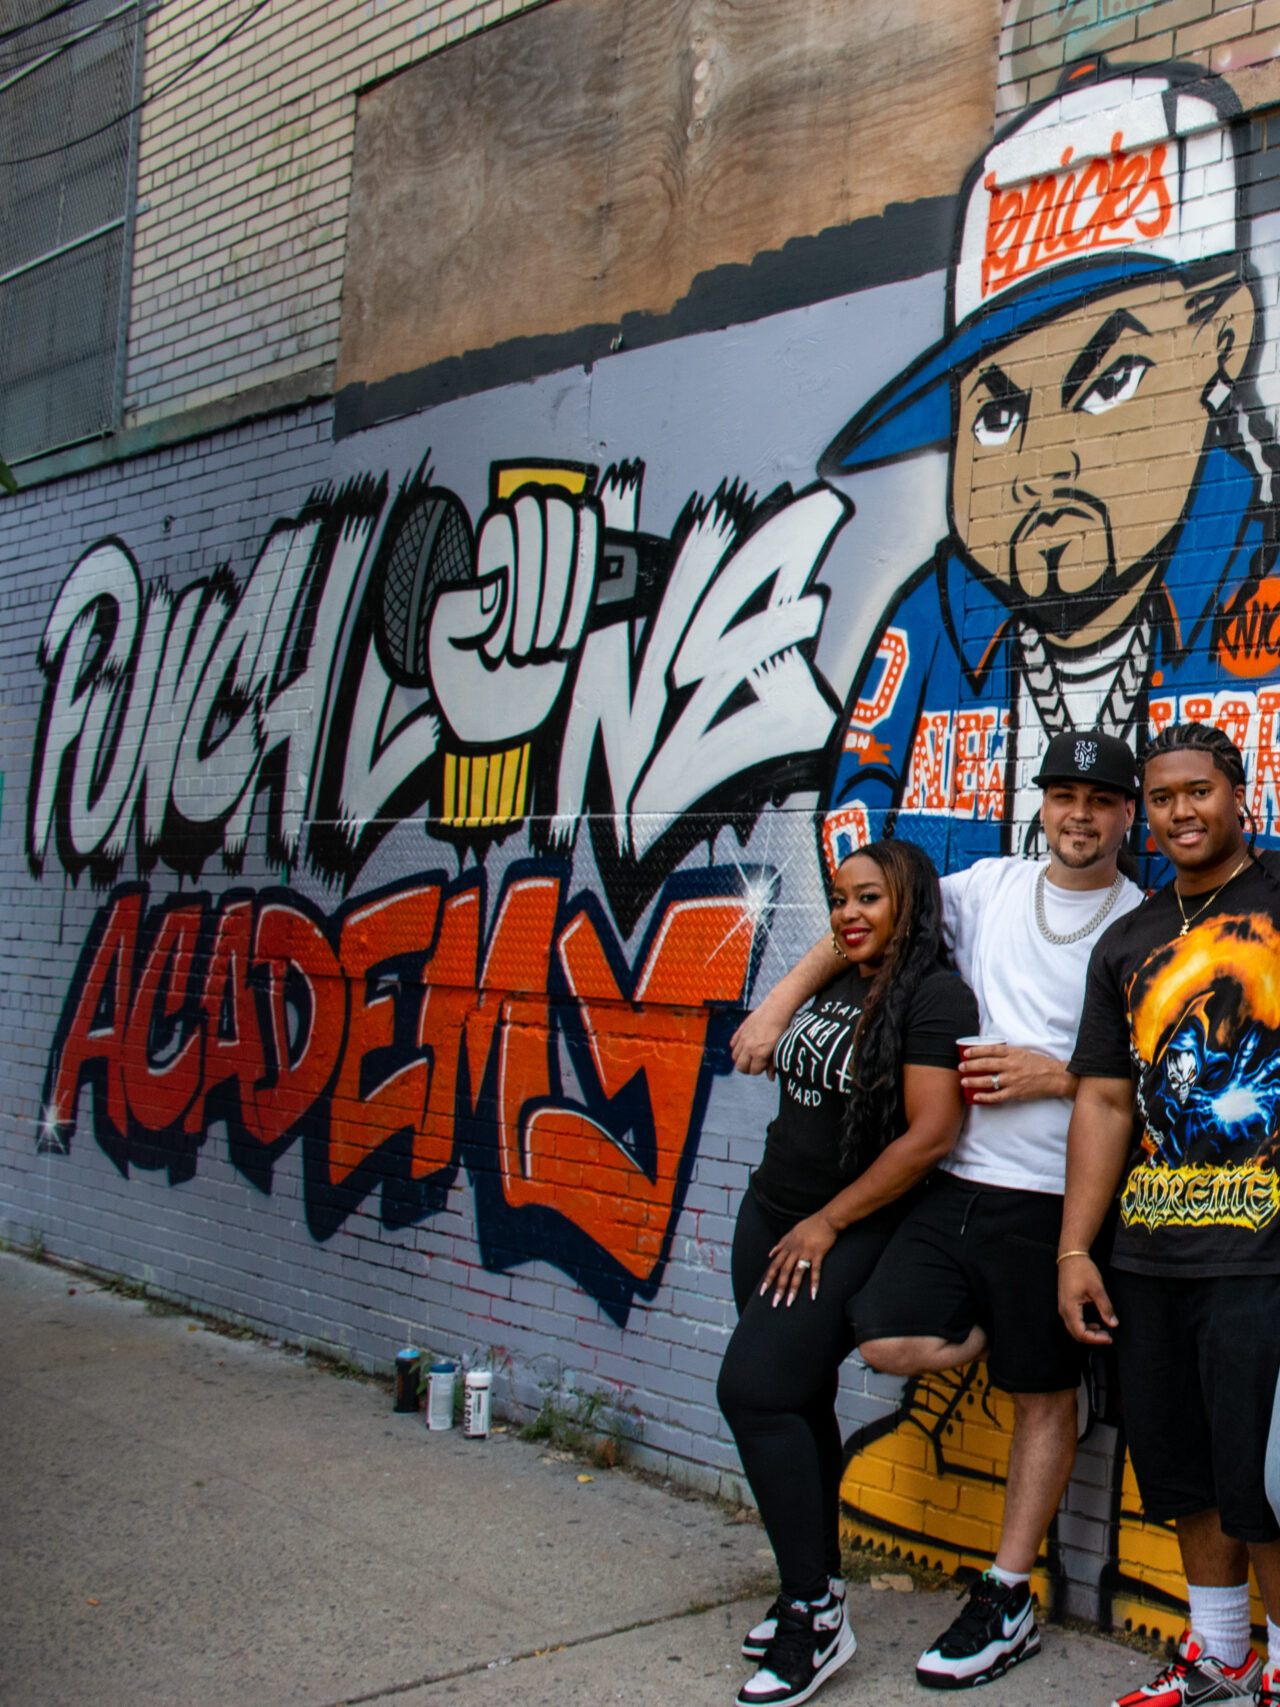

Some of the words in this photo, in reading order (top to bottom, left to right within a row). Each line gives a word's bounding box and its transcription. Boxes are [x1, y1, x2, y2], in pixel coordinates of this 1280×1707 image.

[1074, 740, 1098, 771] NY
[821, 1001, 861, 1020] STAY
[38, 860, 780, 1315] ACADEMY
[787, 1078, 822, 1107] HARD
